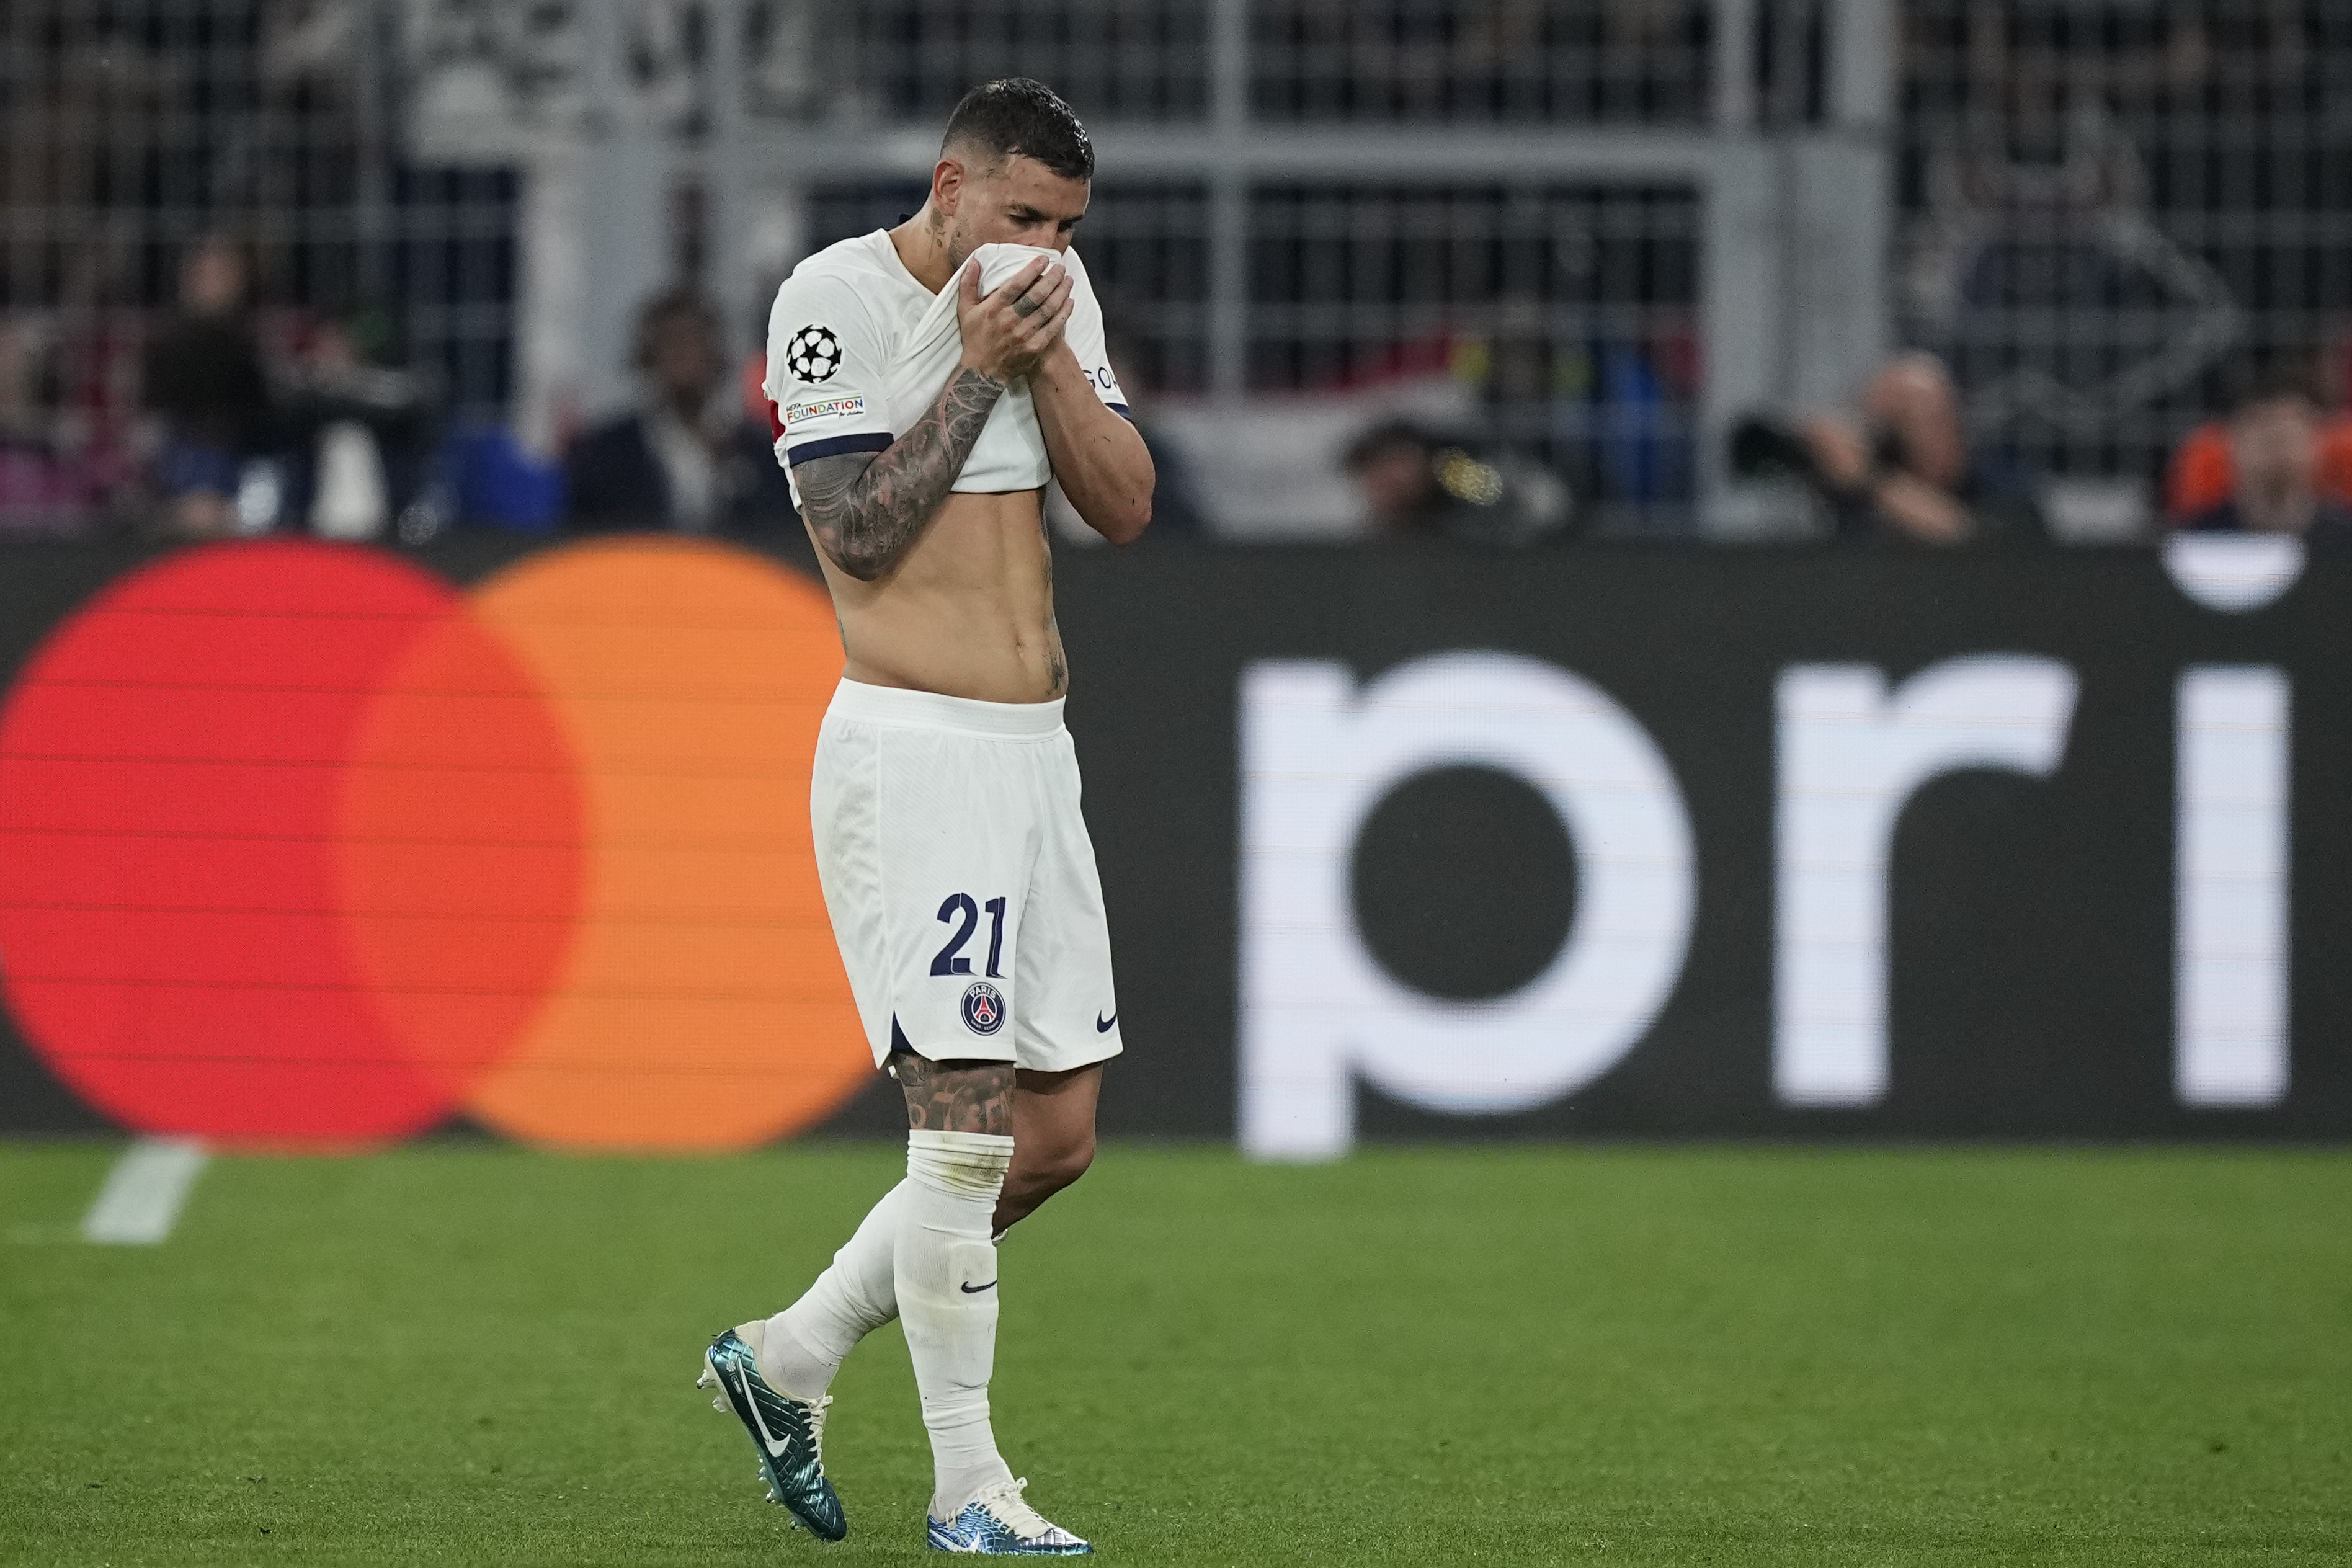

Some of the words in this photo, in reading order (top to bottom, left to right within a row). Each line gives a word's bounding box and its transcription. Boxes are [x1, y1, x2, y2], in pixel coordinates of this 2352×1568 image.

[786, 403, 801, 412] UEFA
[787, 399, 863, 422] FOUNDATION
[1241, 532, 2304, 1162] pri
[929, 892, 1009, 979] 21
[969, 985, 997, 999] PARIS
